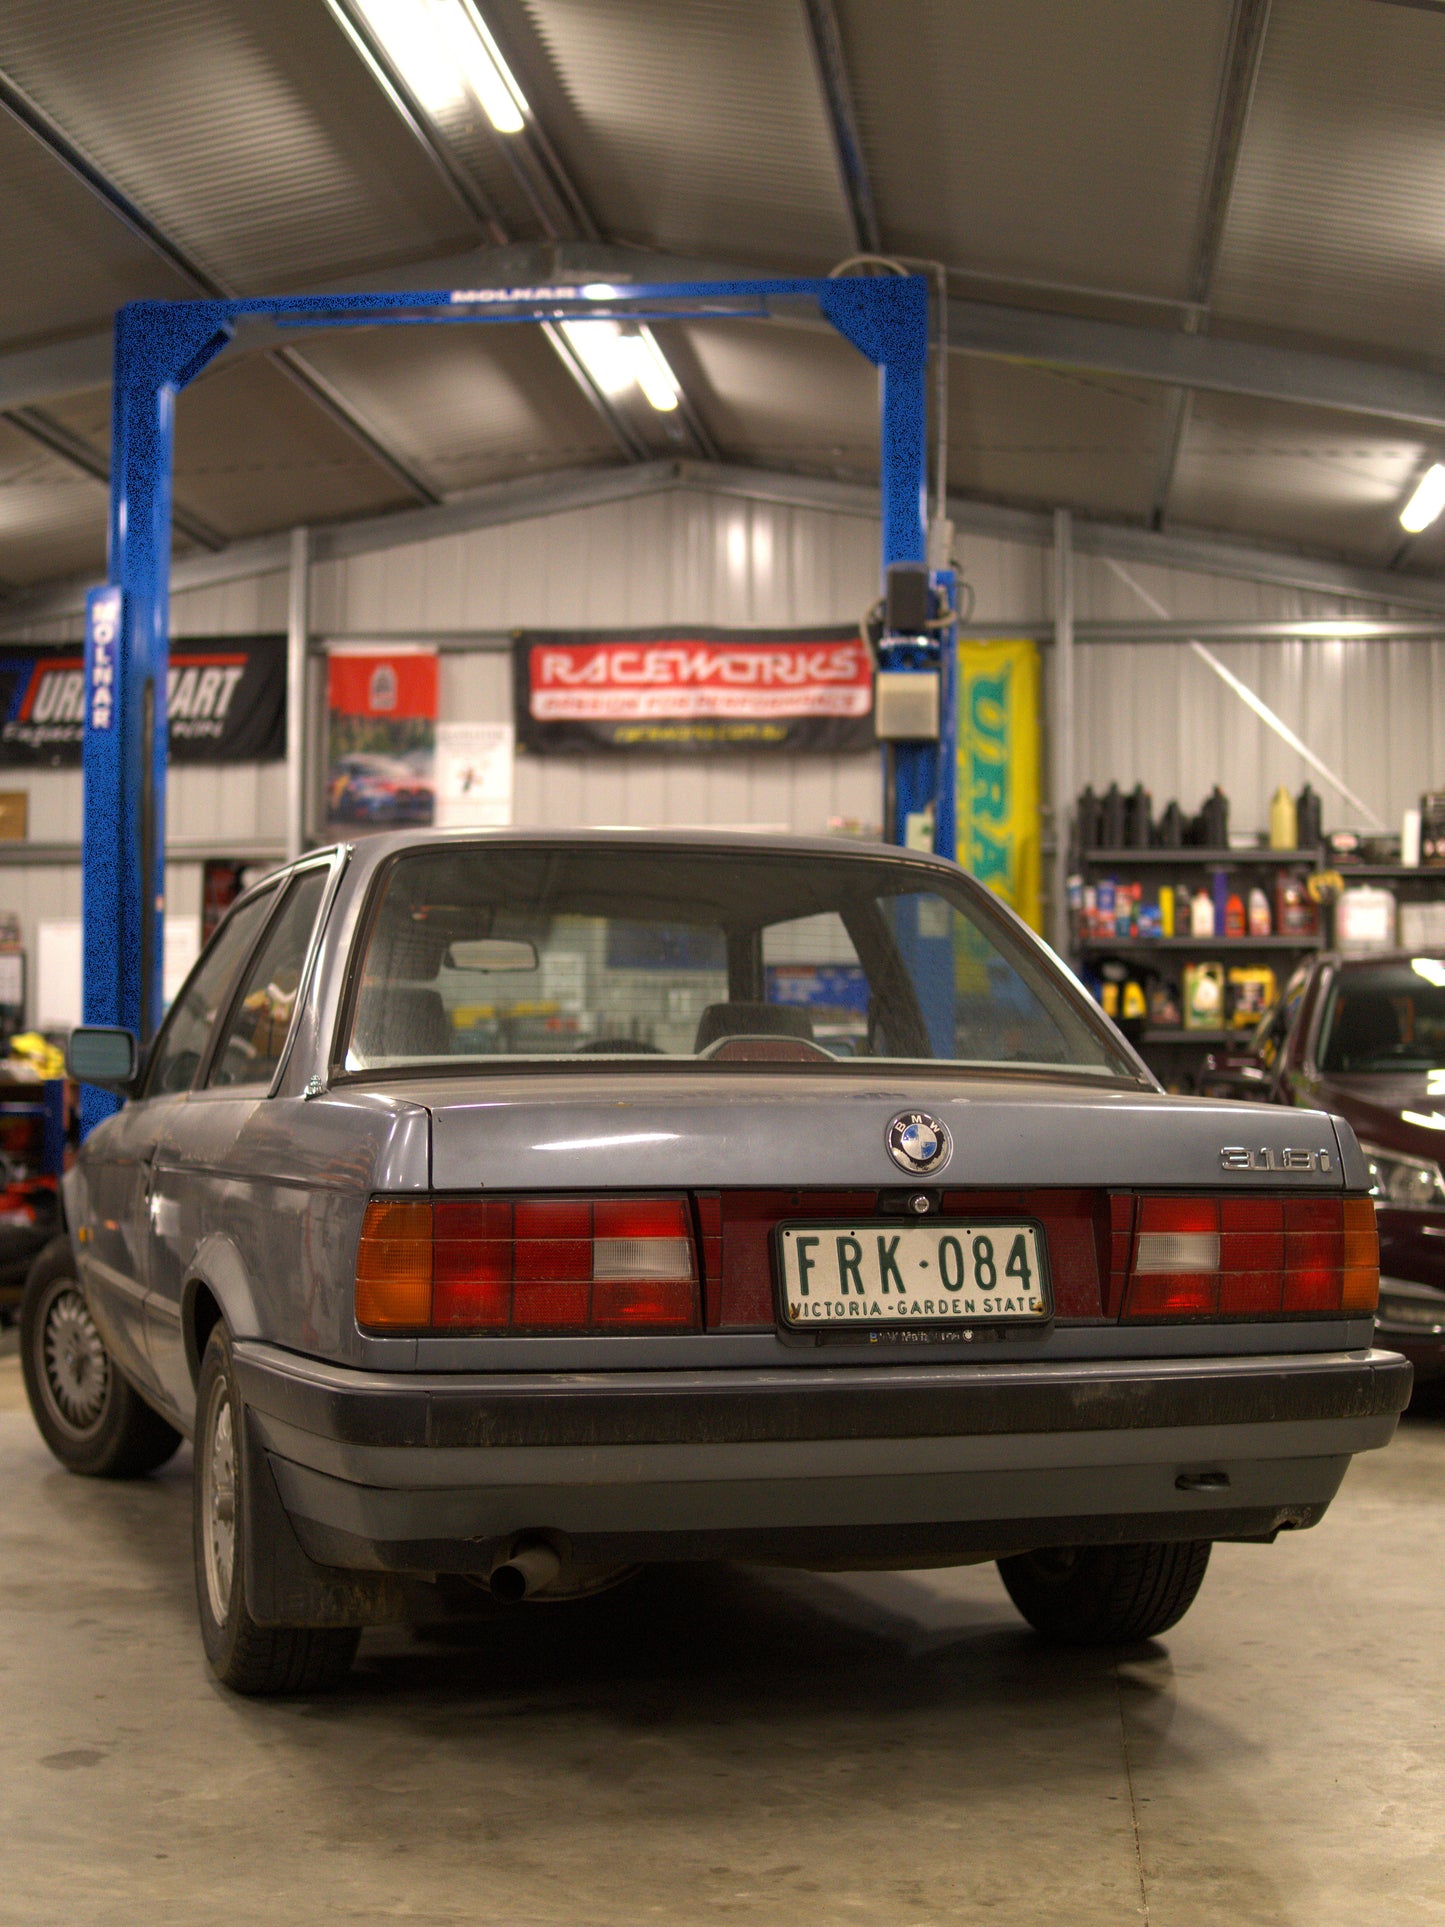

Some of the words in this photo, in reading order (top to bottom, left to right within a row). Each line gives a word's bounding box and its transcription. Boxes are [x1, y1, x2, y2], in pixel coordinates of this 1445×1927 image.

[541, 648, 858, 684] RACEWORKS
[894, 1113, 941, 1133] BMW
[1220, 1146, 1331, 1172] 318i
[983, 1296, 1042, 1313] STATE
